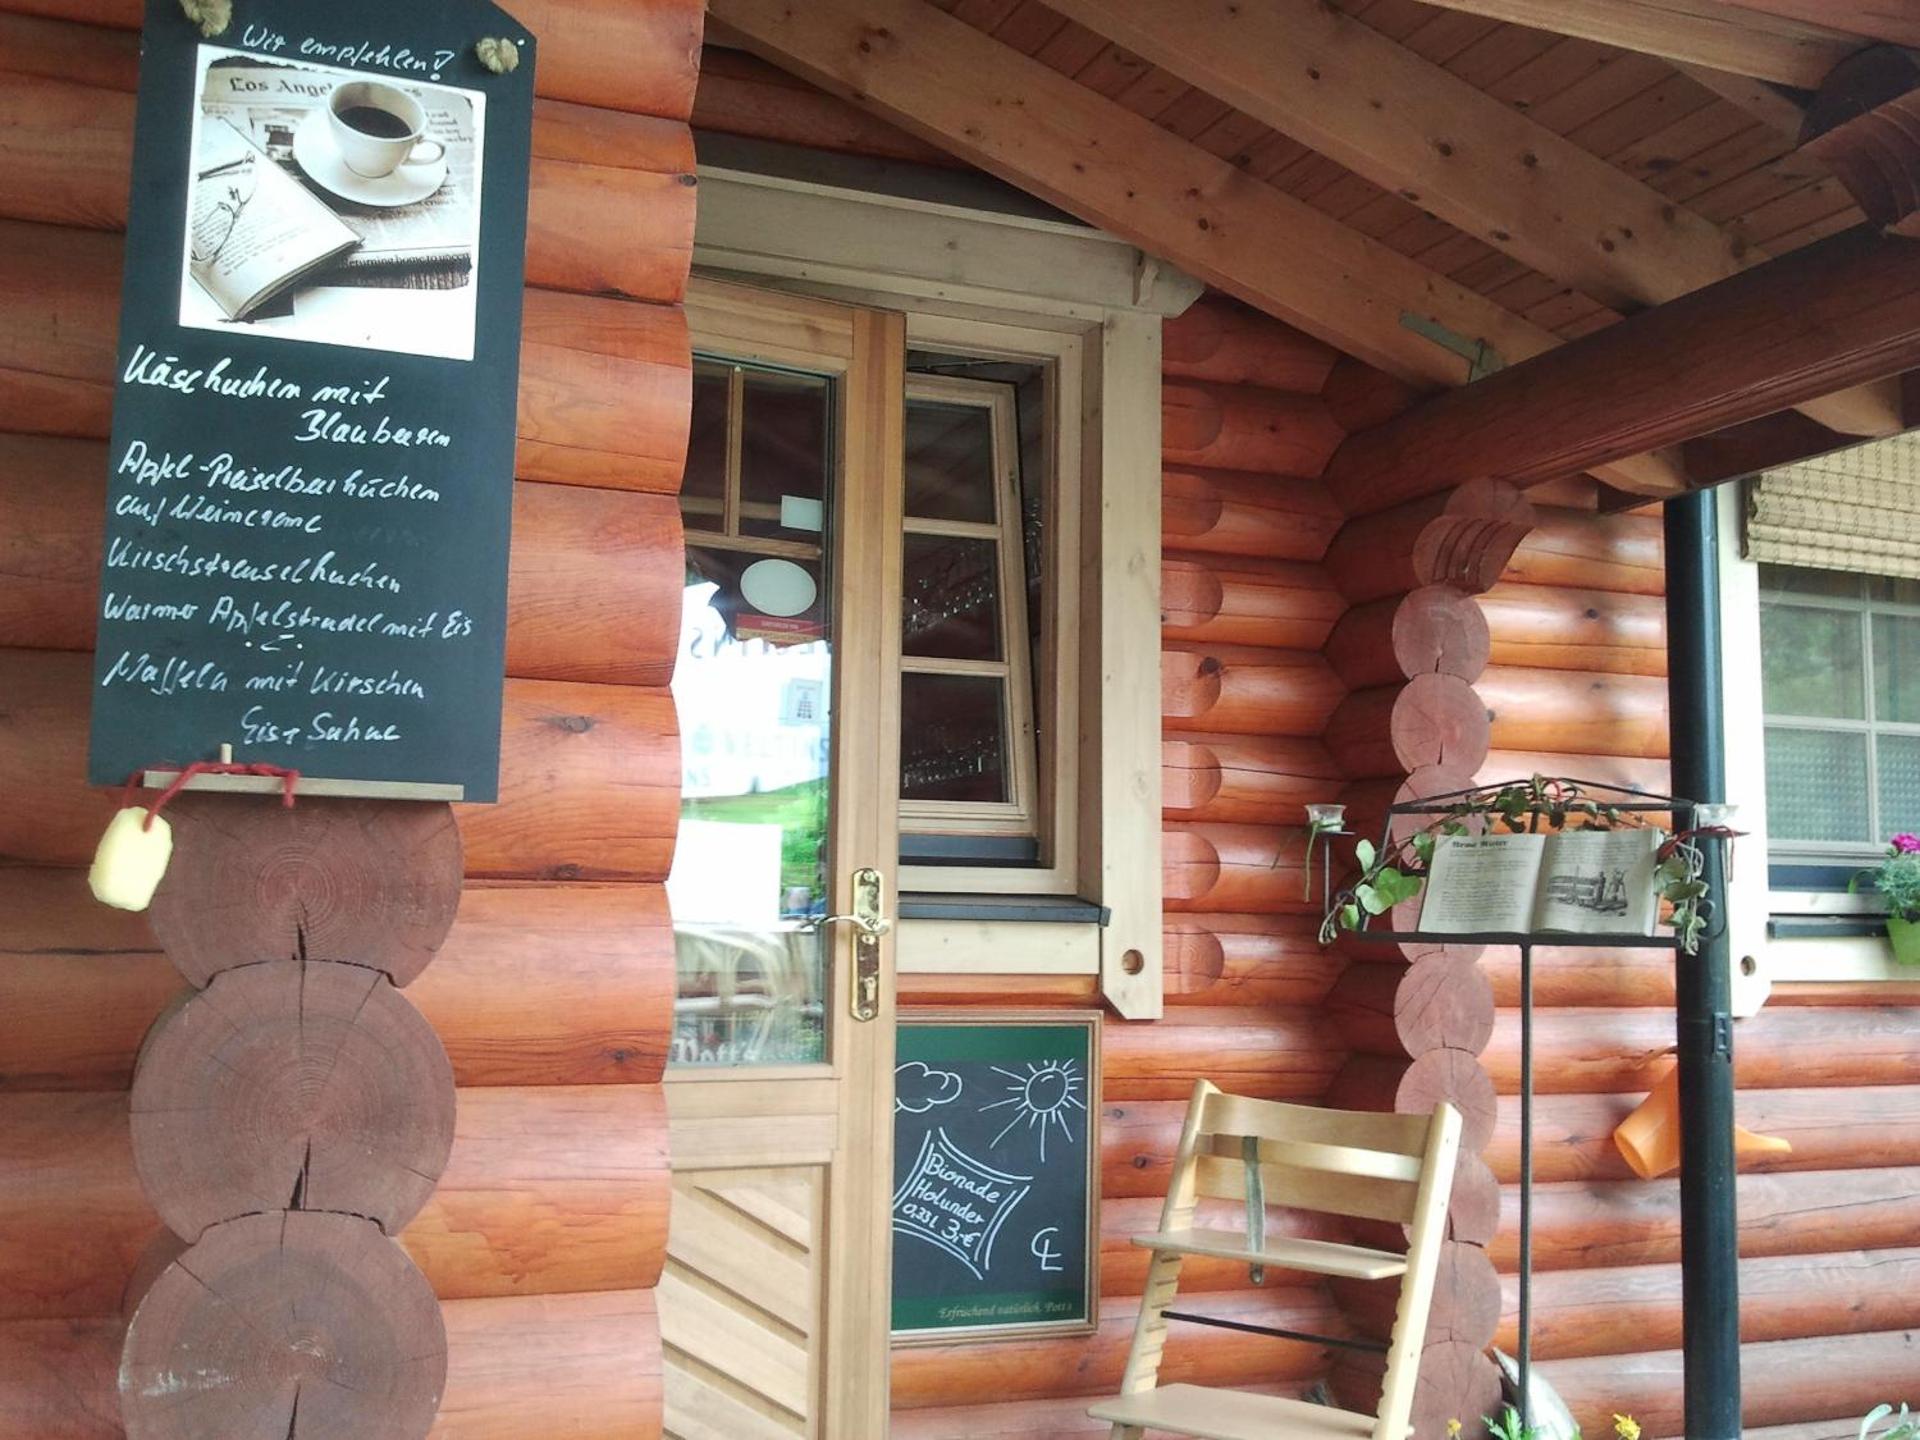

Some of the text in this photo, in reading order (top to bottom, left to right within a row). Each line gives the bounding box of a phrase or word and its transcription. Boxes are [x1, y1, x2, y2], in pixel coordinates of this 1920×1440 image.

[242, 24, 287, 52] Wir
[229, 77, 269, 93] Los
[312, 376, 390, 405] mit
[381, 612, 438, 638] mit
[441, 610, 473, 639] Eis
[245, 661, 304, 692] mit
[924, 1152, 1001, 1203] Bionade
[910, 1178, 985, 1224] Holunder
